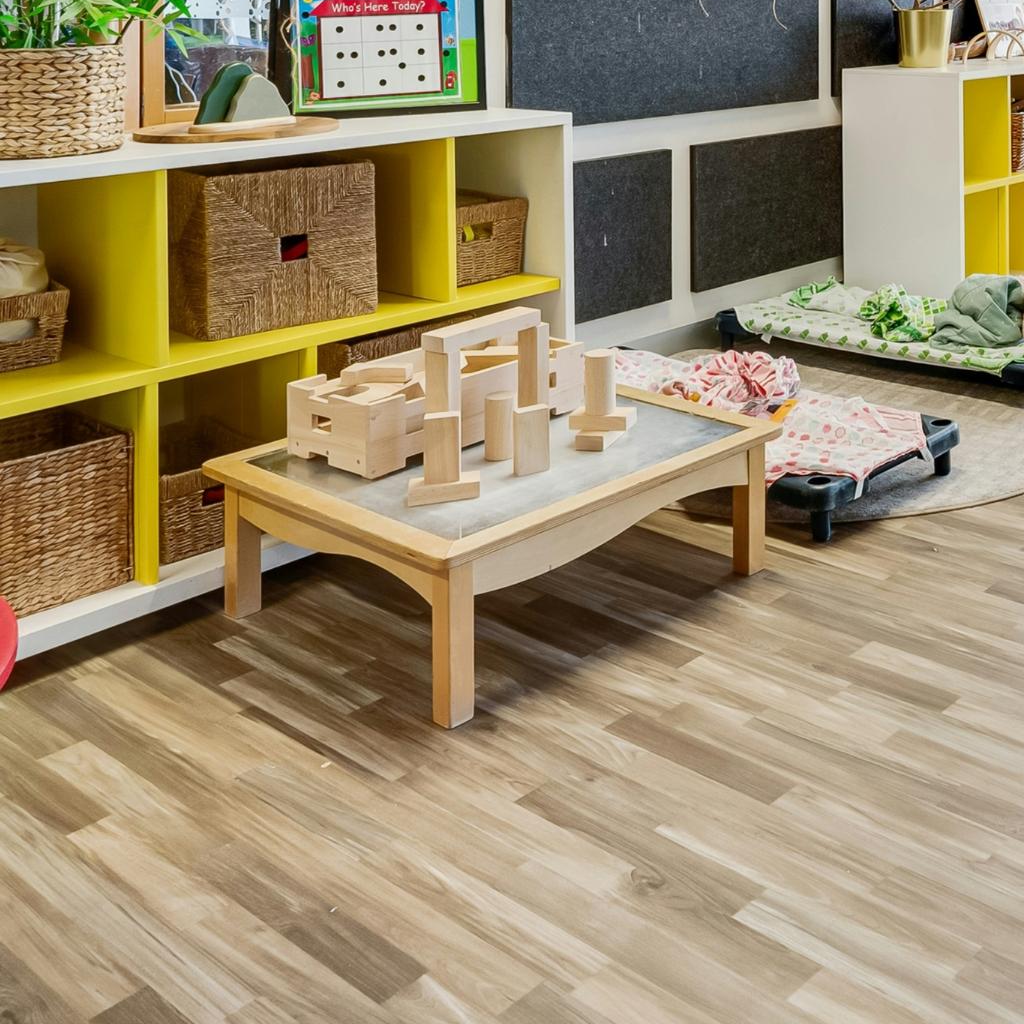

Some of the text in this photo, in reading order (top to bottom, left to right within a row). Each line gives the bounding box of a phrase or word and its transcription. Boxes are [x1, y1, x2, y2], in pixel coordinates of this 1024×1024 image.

[331, 0, 426, 12] Who's Here Today?
